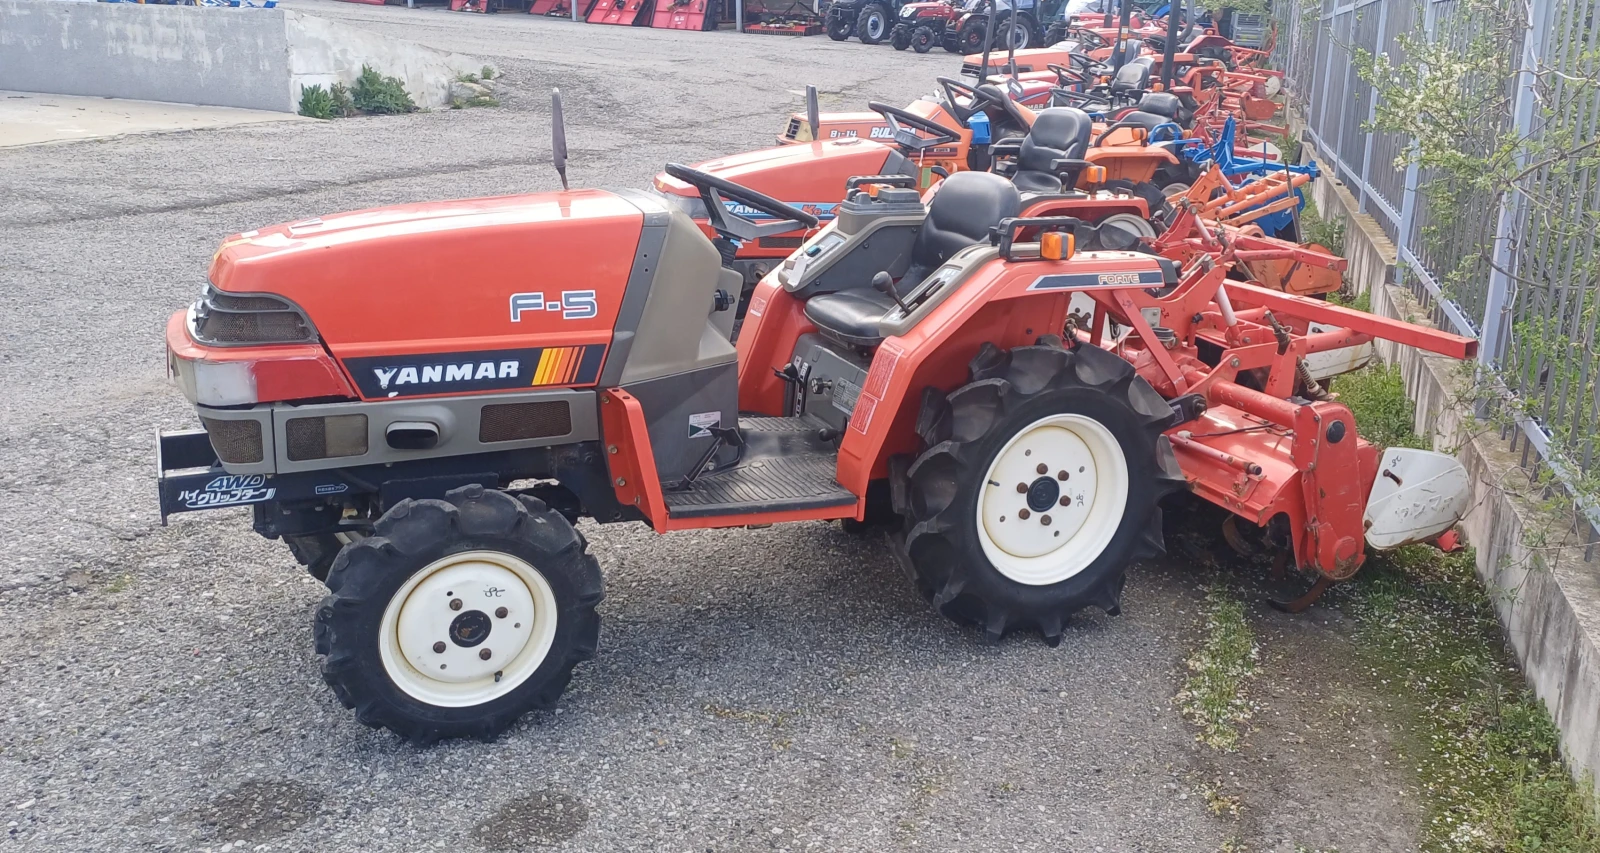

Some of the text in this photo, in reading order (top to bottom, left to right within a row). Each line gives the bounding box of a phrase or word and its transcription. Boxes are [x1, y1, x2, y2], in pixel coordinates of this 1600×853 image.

[1098, 274, 1141, 285] FORTE
[509, 289, 598, 322] F-5
[374, 360, 519, 389] YANMAR
[205, 474, 265, 491] 4WD
